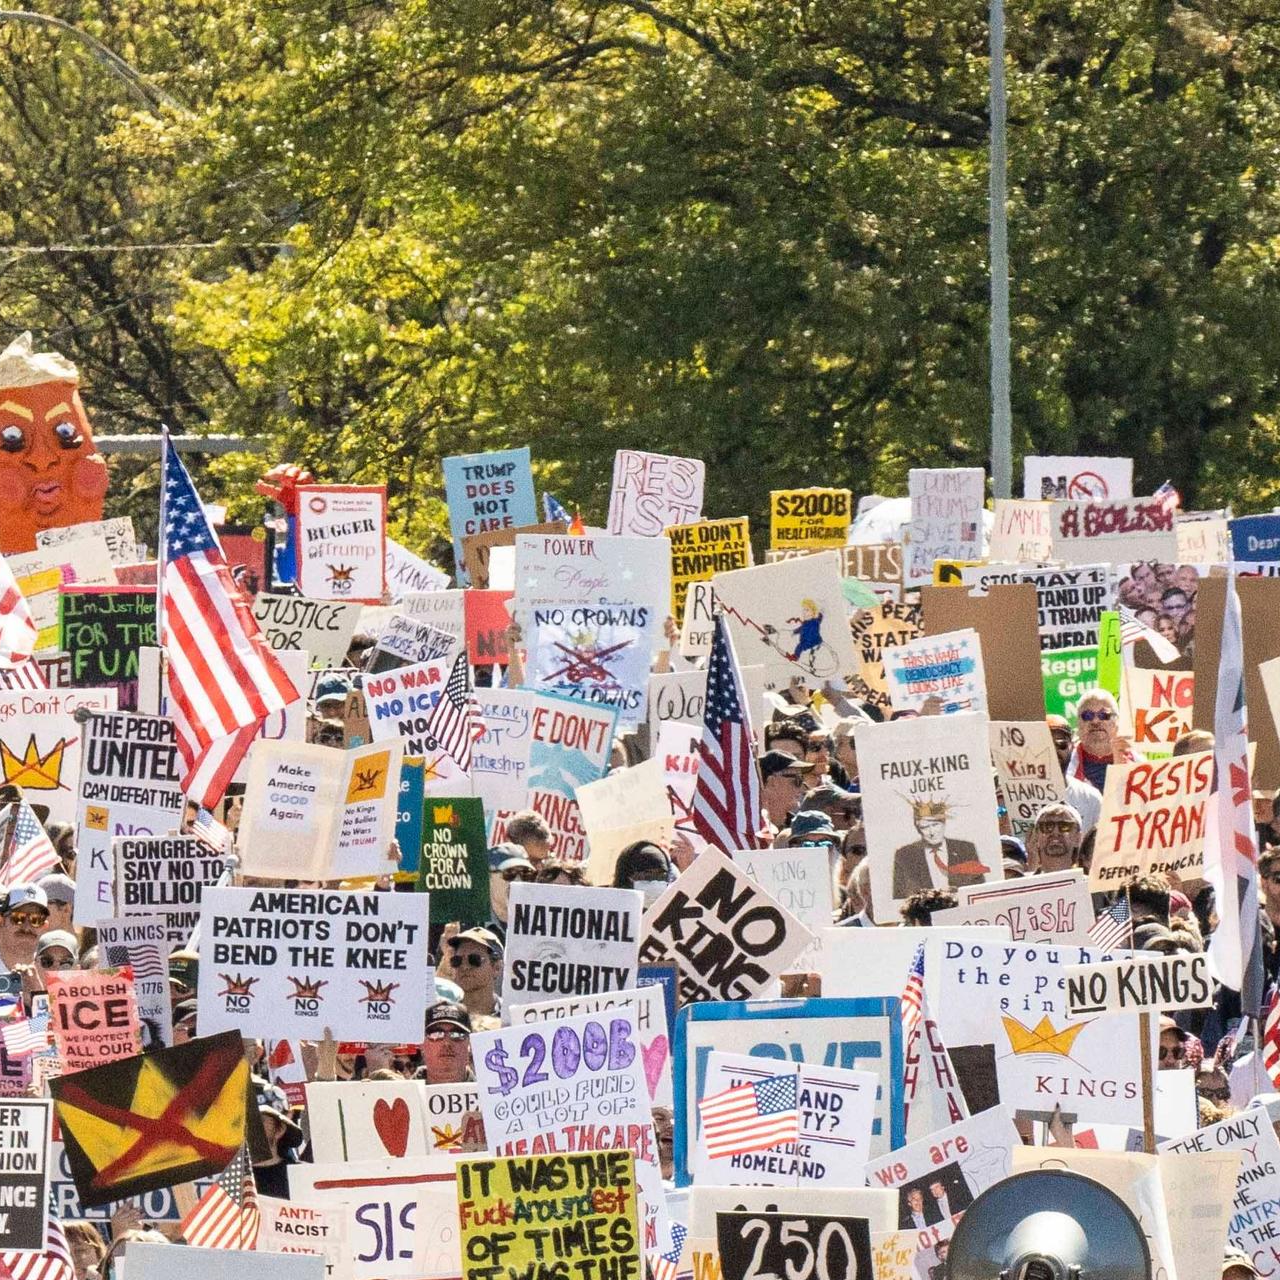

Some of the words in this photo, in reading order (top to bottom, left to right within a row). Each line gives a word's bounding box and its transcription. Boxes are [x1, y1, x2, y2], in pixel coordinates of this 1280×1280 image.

[465, 481, 516, 498] DOES
[473, 499, 509, 515] NOT
[776, 493, 847, 517] $200B
[307, 518, 375, 541] BUGGER
[534, 610, 564, 628] NO
[571, 607, 649, 628] CROWNS
[368, 681, 396, 698] NO
[399, 669, 442, 691] WAR
[277, 763, 311, 777] Make
[880, 755, 970, 778] FAUX-KING
[267, 778, 316, 793] America
[909, 776, 945, 794] JOKE
[269, 807, 305, 821] Again
[434, 829, 452, 844] NO
[423, 843, 469, 859] CROWN
[430, 858, 454, 874] FOR
[456, 858, 467, 873] A
[426, 874, 471, 890] CLOWN
[250, 892, 379, 916] AMERICAN
[695, 872, 788, 955] NO
[99, 927, 117, 943] NO
[122, 924, 164, 942] KINGS
[213, 918, 330, 941] PATRIOTS
[346, 920, 419, 944] DON'T
[513, 903, 634, 942] NATIONAL
[214, 944, 278, 965] BEND
[288, 945, 334, 967] THE
[345, 946, 408, 969] KNEE
[511, 960, 629, 993] SECURITY
[1068, 975, 1107, 1007] NO
[1119, 957, 1210, 1005] KINGS
[57, 982, 127, 998] ABOLISH
[58, 1001, 130, 1030] ICE
[485, 1018, 637, 1097] $200B
[1036, 1076, 1137, 1099] KINGS
[10, 1131, 29, 1148] IN
[1216, 1115, 1260, 1147] ONLY
[730, 1154, 827, 1181] HOMELAND
[873, 1162, 908, 1186] we
[929, 1136, 970, 1161] are
[466, 1231, 517, 1266] OF
[525, 1217, 635, 1261] TIMES
